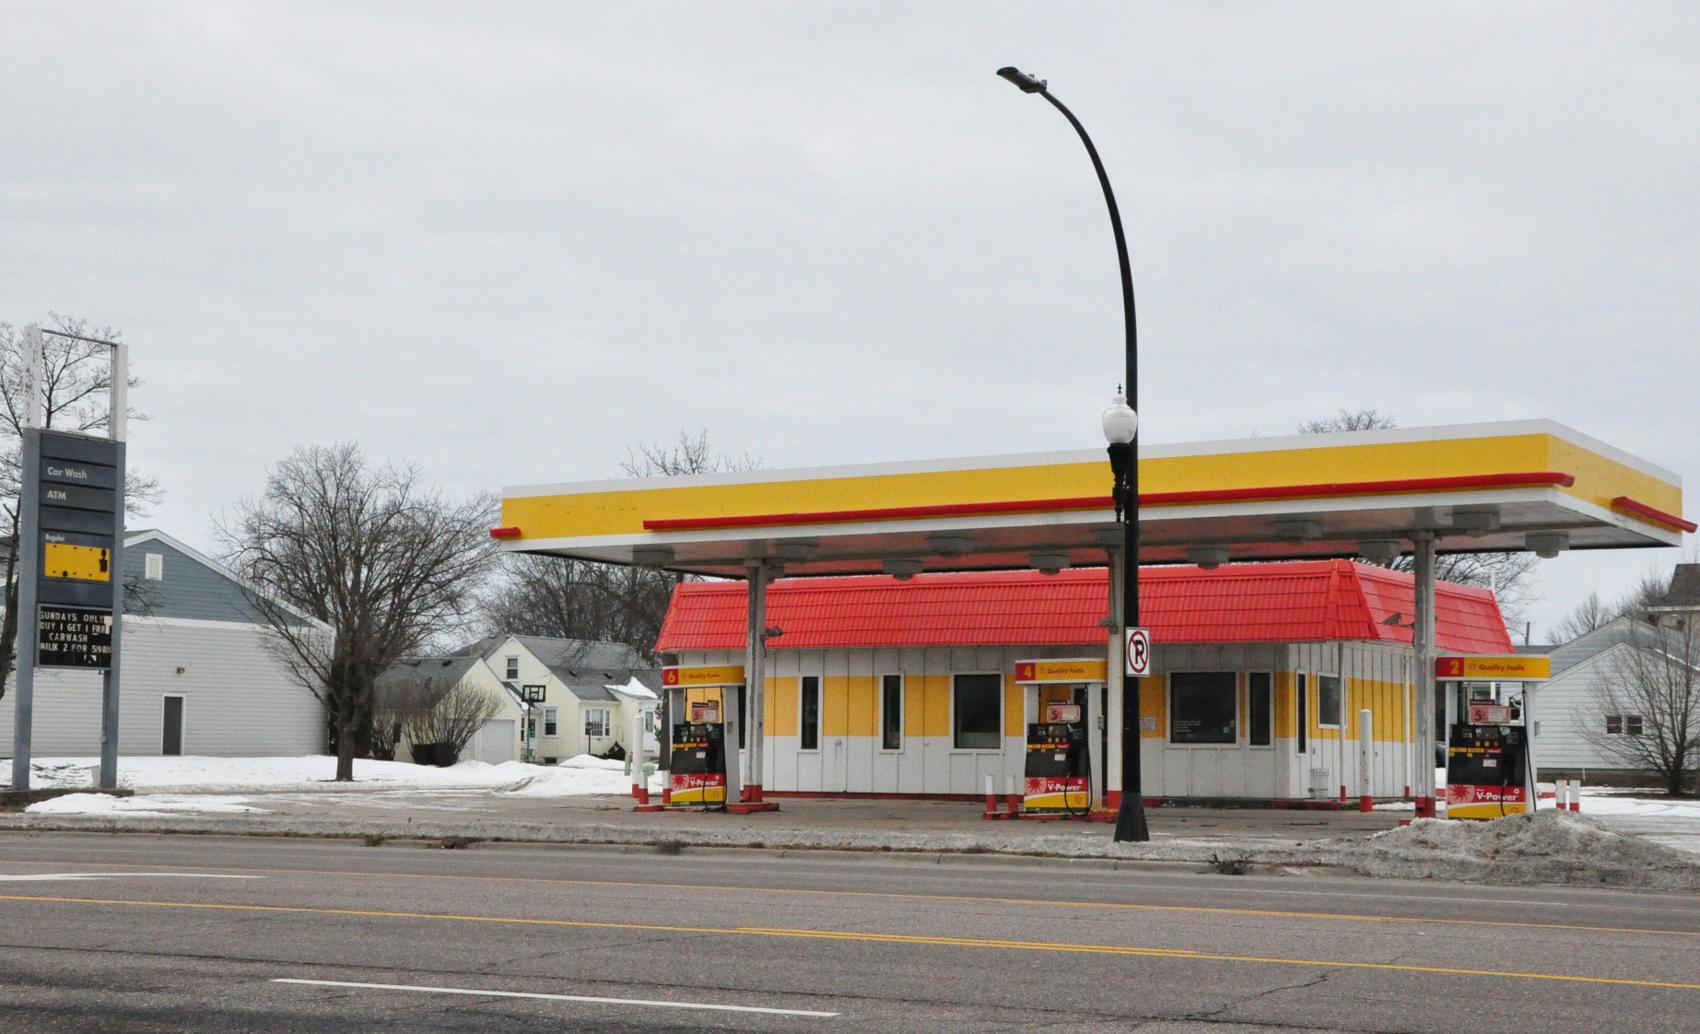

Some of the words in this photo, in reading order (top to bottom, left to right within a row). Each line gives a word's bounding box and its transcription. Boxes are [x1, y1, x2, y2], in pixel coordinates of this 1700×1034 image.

[47, 466, 63, 476] Car
[65, 468, 87, 479] Wash
[47, 490, 67, 500] ATM
[40, 611, 77, 622] SUNDAYS
[83, 614, 104, 623] ONLY
[67, 623, 81, 632] GET
[92, 624, 109, 634] FRE
[49, 632, 88, 643] CARWASH
[62, 643, 68, 652] 2
[71, 644, 88, 652] FOR
[1134, 639, 1144, 665] P
[1024, 664, 1032, 678] 4
[1450, 659, 1460, 675] 2
[668, 671, 676, 683] 6
[1047, 783, 1081, 792] V-Power
[1476, 792, 1518, 801] V-Power
